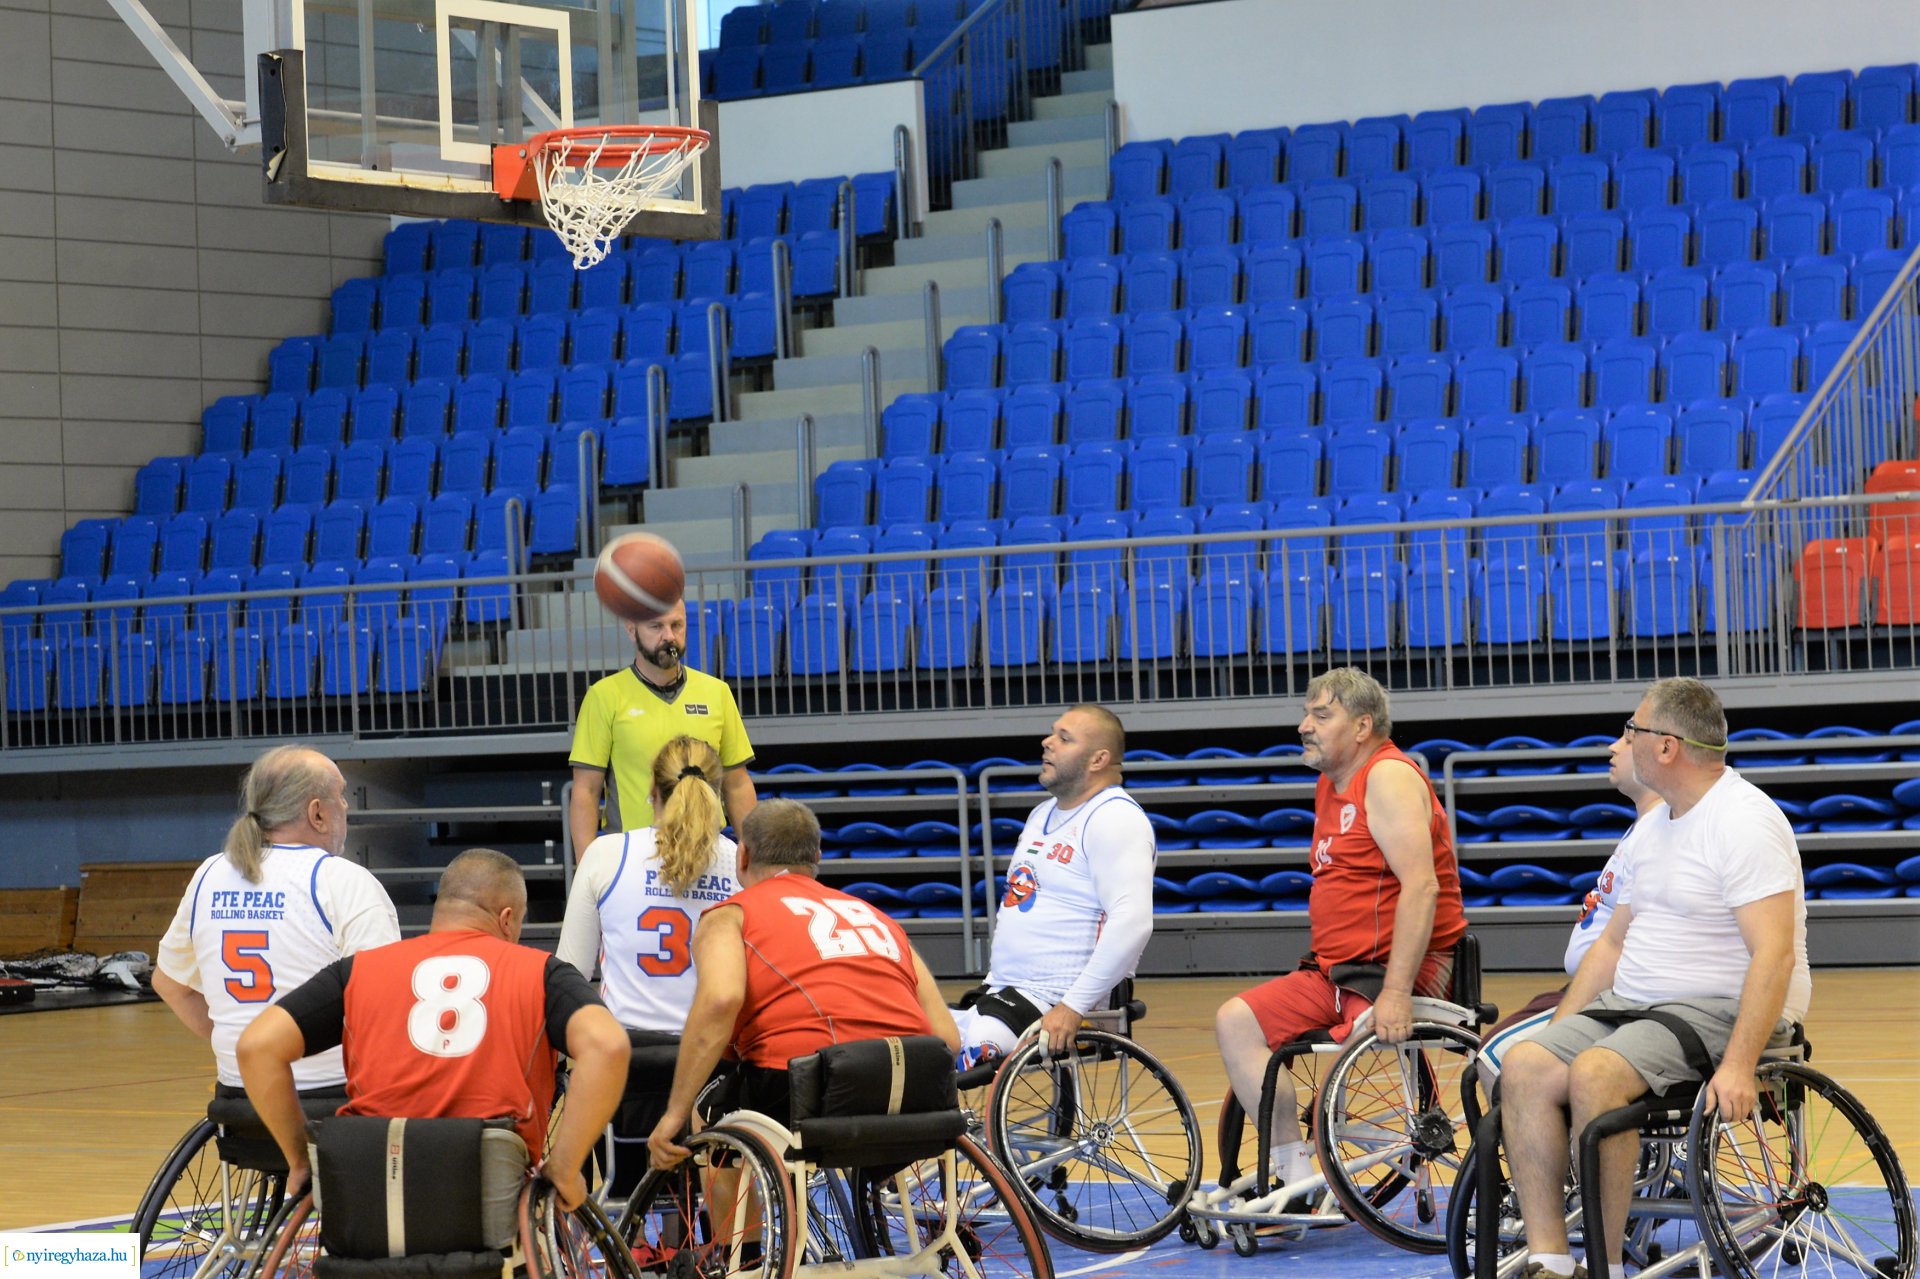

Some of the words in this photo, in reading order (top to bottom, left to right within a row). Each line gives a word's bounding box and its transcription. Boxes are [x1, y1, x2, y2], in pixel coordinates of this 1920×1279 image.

[1046, 843, 1075, 865] 30
[696, 874, 732, 893] EAC
[211, 891, 240, 908] PTE
[243, 891, 286, 909] PEAC
[210, 909, 246, 920] ROLLING
[247, 910, 285, 920] BASKET
[637, 905, 693, 977] 3
[222, 930, 277, 1004] 5
[407, 955, 490, 1058] 8
